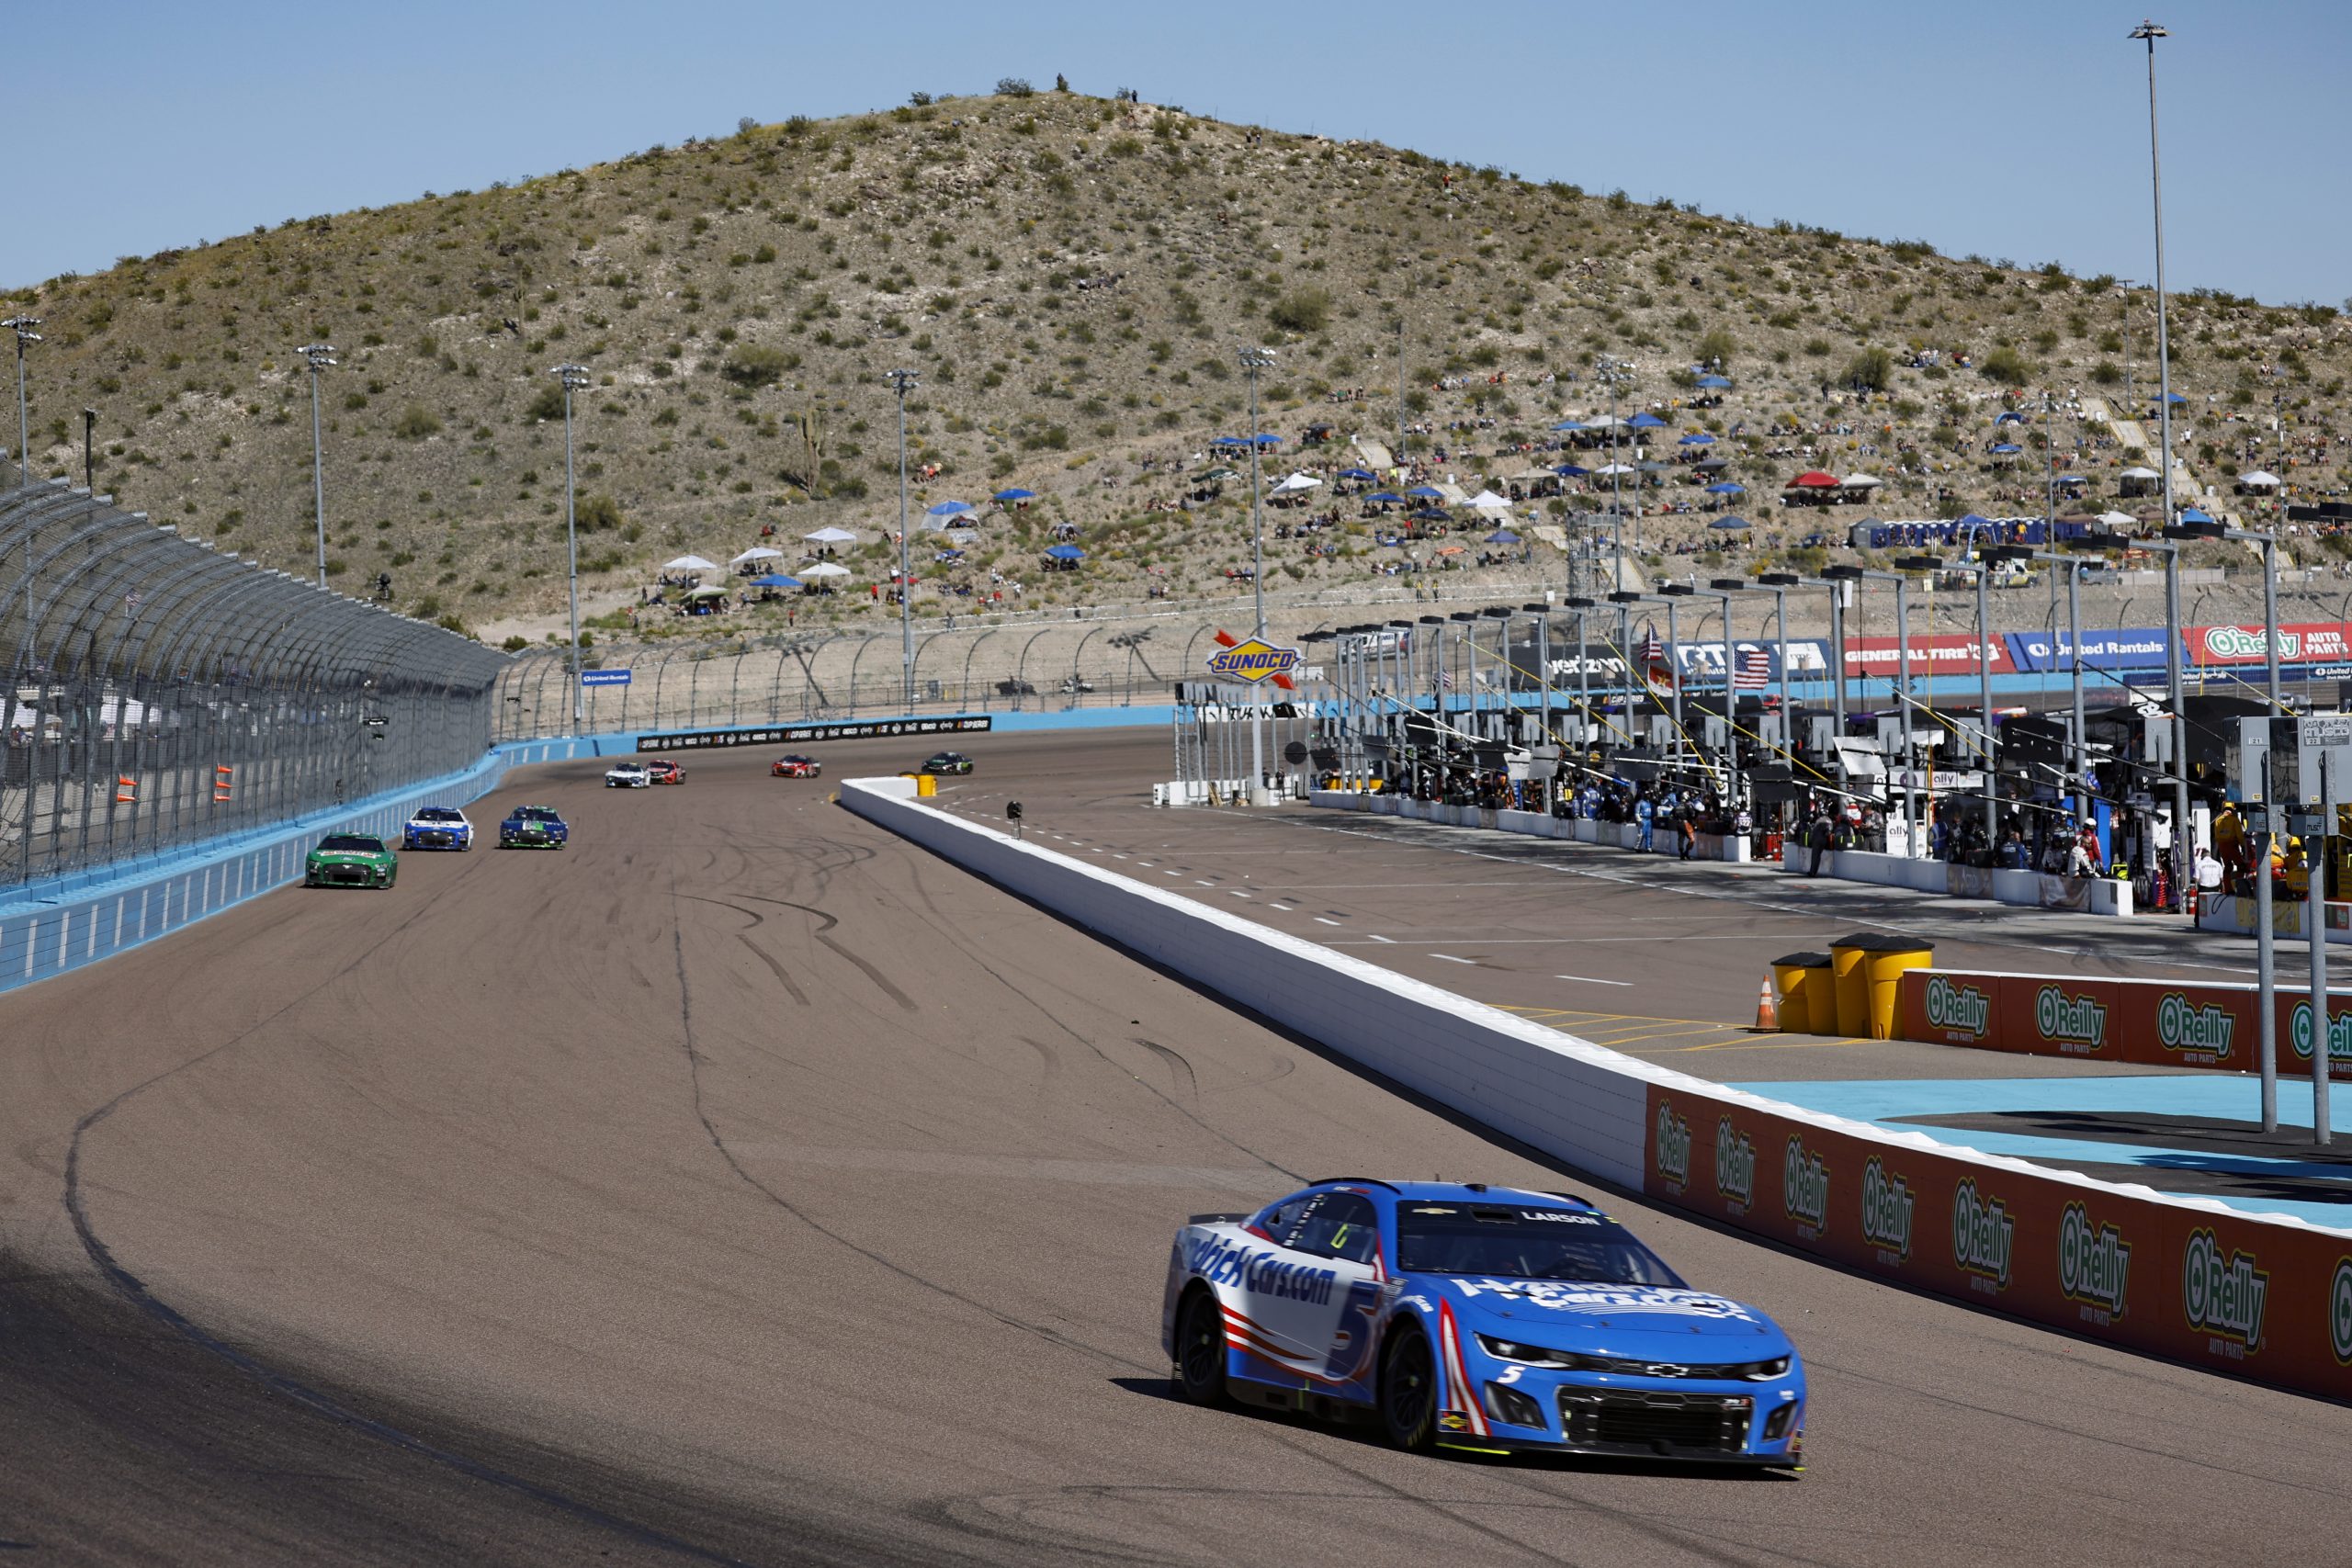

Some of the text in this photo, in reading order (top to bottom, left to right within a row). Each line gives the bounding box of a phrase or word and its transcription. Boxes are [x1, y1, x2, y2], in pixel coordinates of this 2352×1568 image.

[2054, 640, 2165, 655] Unted Rentals
[2304, 642, 2349, 654] PARTS
[2307, 632, 2341, 643] AUTO
[1216, 652, 1293, 670] SUNOCO
[1928, 648, 1968, 660] TIRE
[1934, 773, 1953, 785] ally
[1889, 826, 1908, 837] ally
[1928, 978, 1987, 1032] O'Reilly
[2038, 988, 2105, 1043] O'Reilly
[2160, 998, 2232, 1053] O'Reilly
[1947, 1032, 1973, 1043] AUTO PARTS
[2060, 1043, 2089, 1054] AUTO PARTS
[2184, 1053, 2216, 1065] AUTO PARTS
[1658, 1108, 1690, 1182] O'Reilly
[1717, 1123, 1754, 1203] O'Reilly
[1786, 1143, 1827, 1227] O'Reilly
[1521, 1212, 1601, 1225] LARSON
[1862, 1164, 1912, 1253] O'Reilly
[1955, 1187, 2012, 1280] O'Reilly
[2061, 1211, 2128, 1311] O'Reilly
[1971, 1275, 1996, 1296] AUTO PARTS
[2186, 1238, 2264, 1343] O'Reilly
[2080, 1305, 2110, 1327] AUTO PARTS
[2209, 1337, 2244, 1360] AUTO PARTS
[1497, 1366, 1525, 1384] 5
